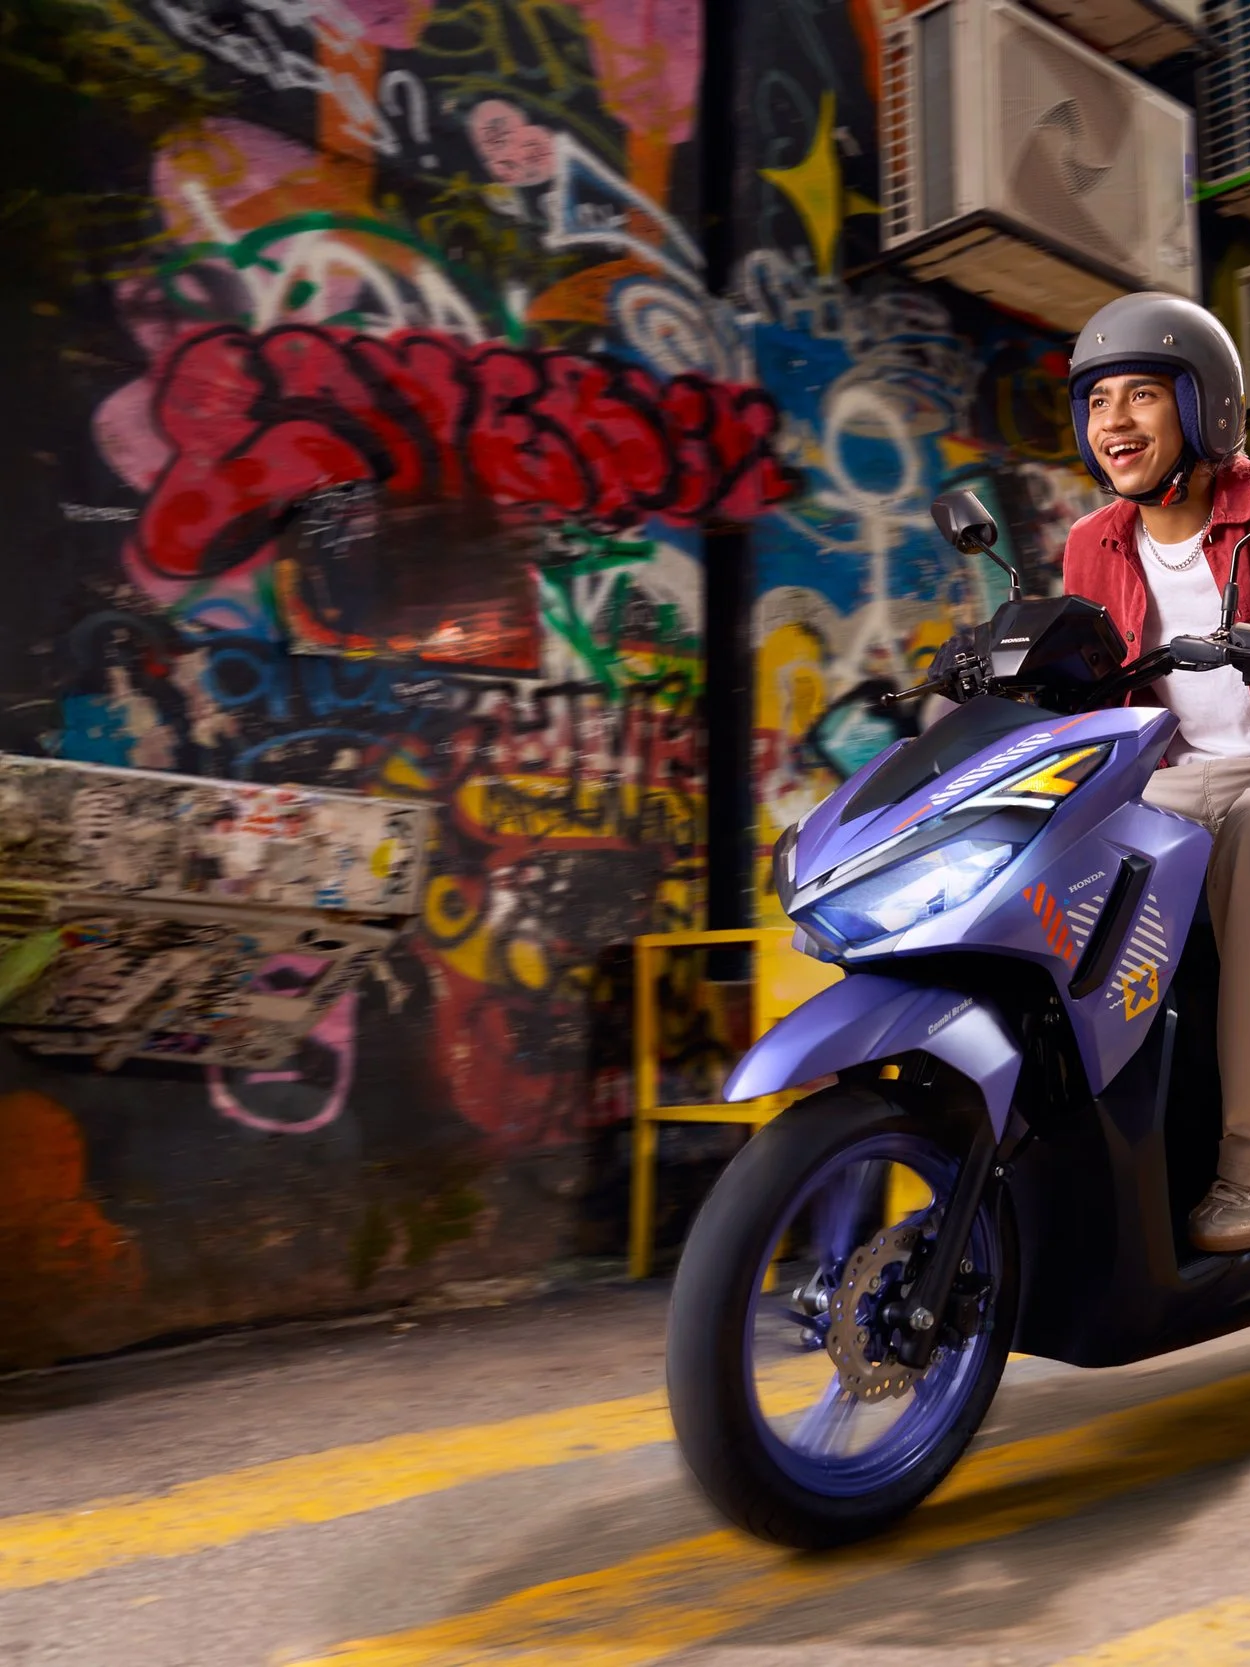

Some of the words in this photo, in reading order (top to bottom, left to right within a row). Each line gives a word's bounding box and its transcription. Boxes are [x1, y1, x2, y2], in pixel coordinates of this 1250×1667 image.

[1068, 871, 1106, 893] HONDA
[928, 1010, 952, 1035] Combi
[952, 997, 973, 1017] Brake
